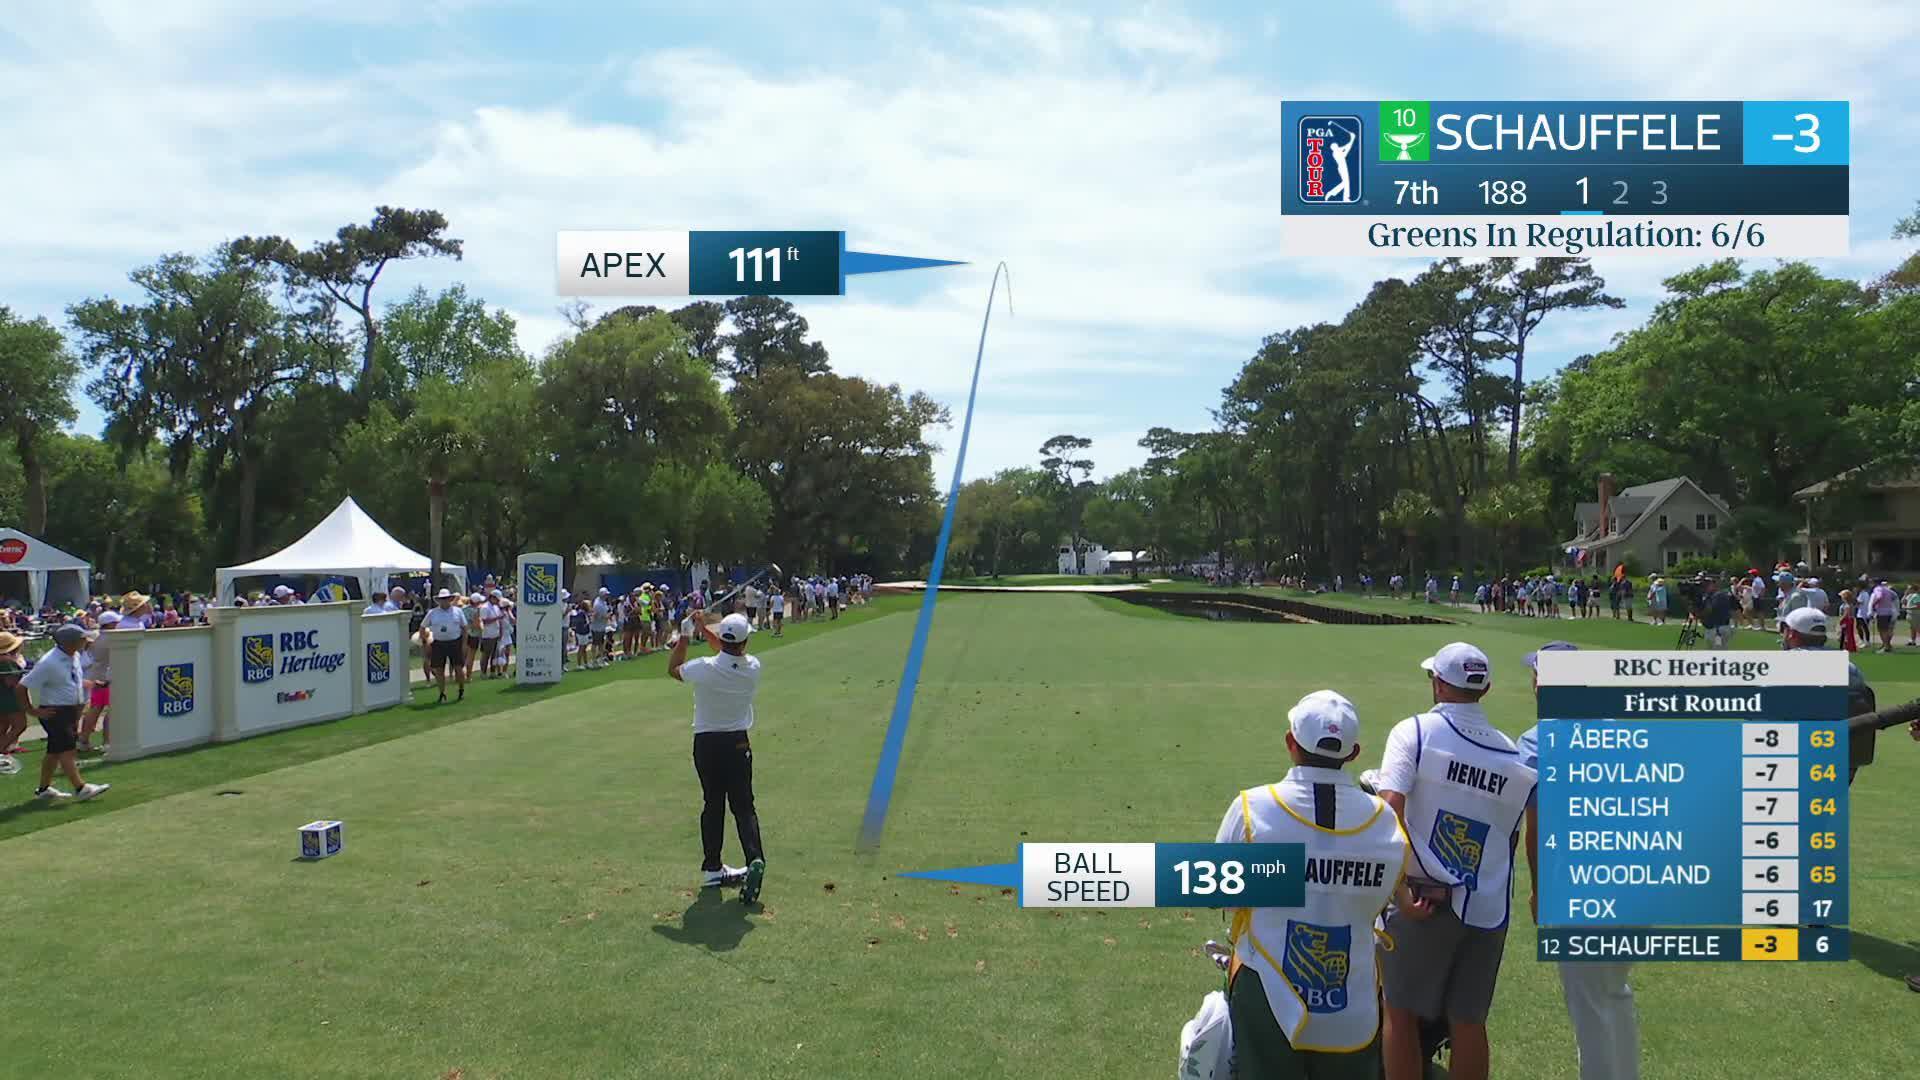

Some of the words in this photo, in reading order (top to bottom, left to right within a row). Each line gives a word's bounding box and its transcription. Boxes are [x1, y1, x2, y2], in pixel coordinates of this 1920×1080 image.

[527, 592, 555, 603] RBC
[534, 611, 548, 632] 7
[280, 630, 320, 652] RBC
[247, 667, 273, 681] RBC
[280, 652, 346, 675] Heritage
[370, 670, 389, 682] RBC
[163, 698, 192, 714] RBC
[1446, 760, 1508, 796] HENLEY
[1293, 983, 1342, 1008] BC
